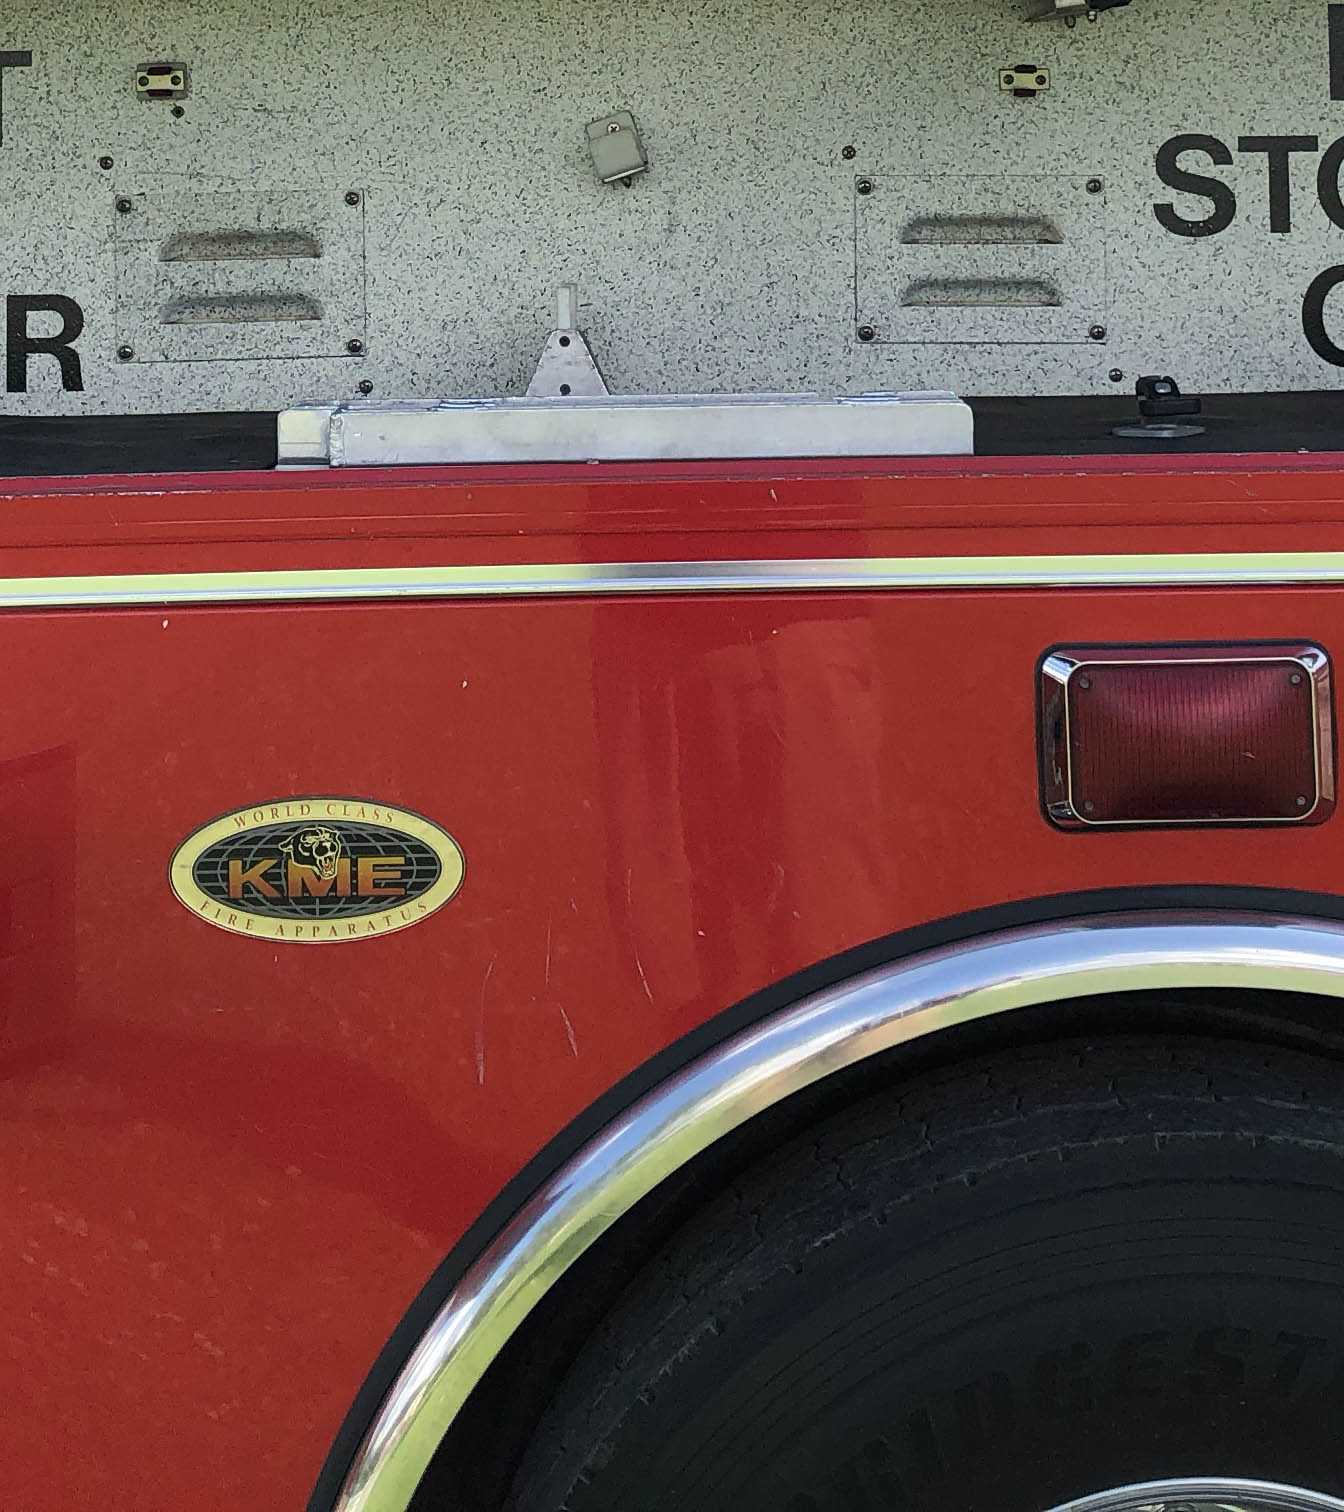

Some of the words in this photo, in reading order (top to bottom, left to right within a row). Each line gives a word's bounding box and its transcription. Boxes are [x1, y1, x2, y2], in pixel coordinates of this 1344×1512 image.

[232, 803, 313, 828] WORLD
[326, 803, 395, 824] CLASS
[227, 855, 407, 899] KME
[200, 899, 254, 932] FIRE
[274, 900, 428, 938] APPARATUS
